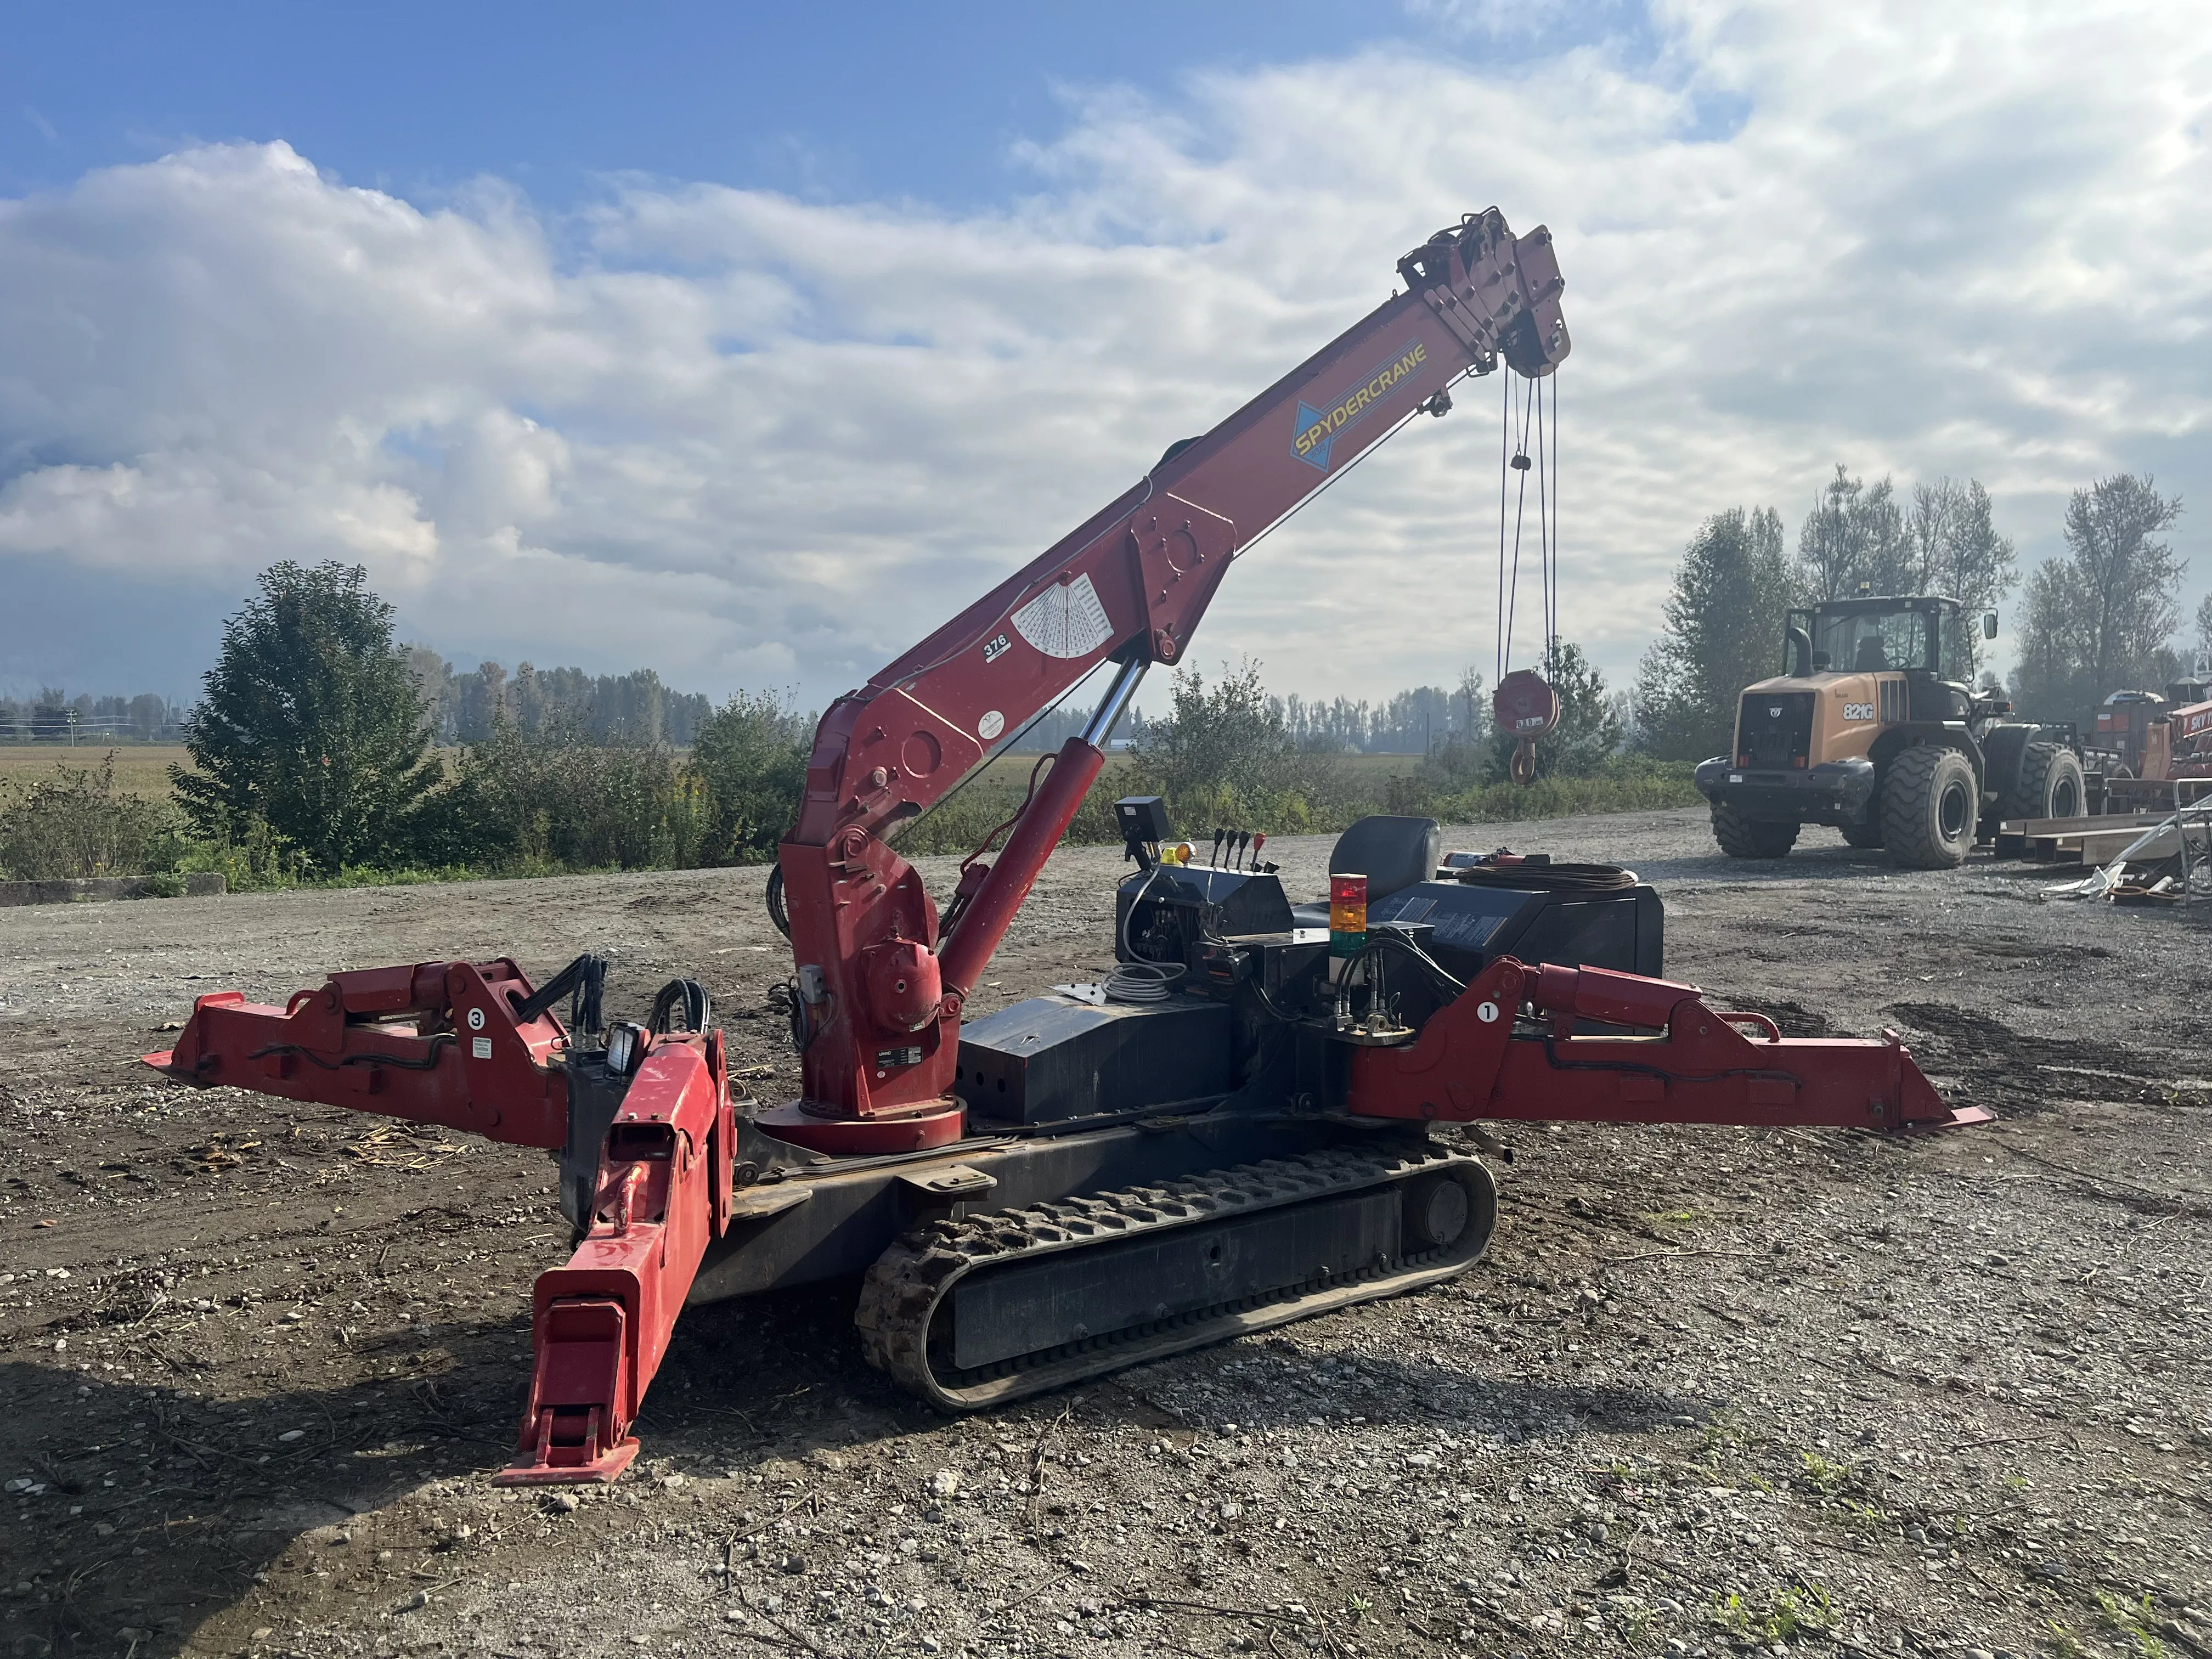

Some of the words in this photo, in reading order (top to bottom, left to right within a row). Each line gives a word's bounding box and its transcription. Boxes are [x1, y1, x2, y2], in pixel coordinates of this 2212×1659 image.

[1295, 344, 1427, 456] SPYDERCRANE
[984, 635, 1006, 656] 376
[1843, 703, 1874, 720] 821G
[471, 1012, 481, 1026] 3
[1484, 1005, 1490, 1019] 1
